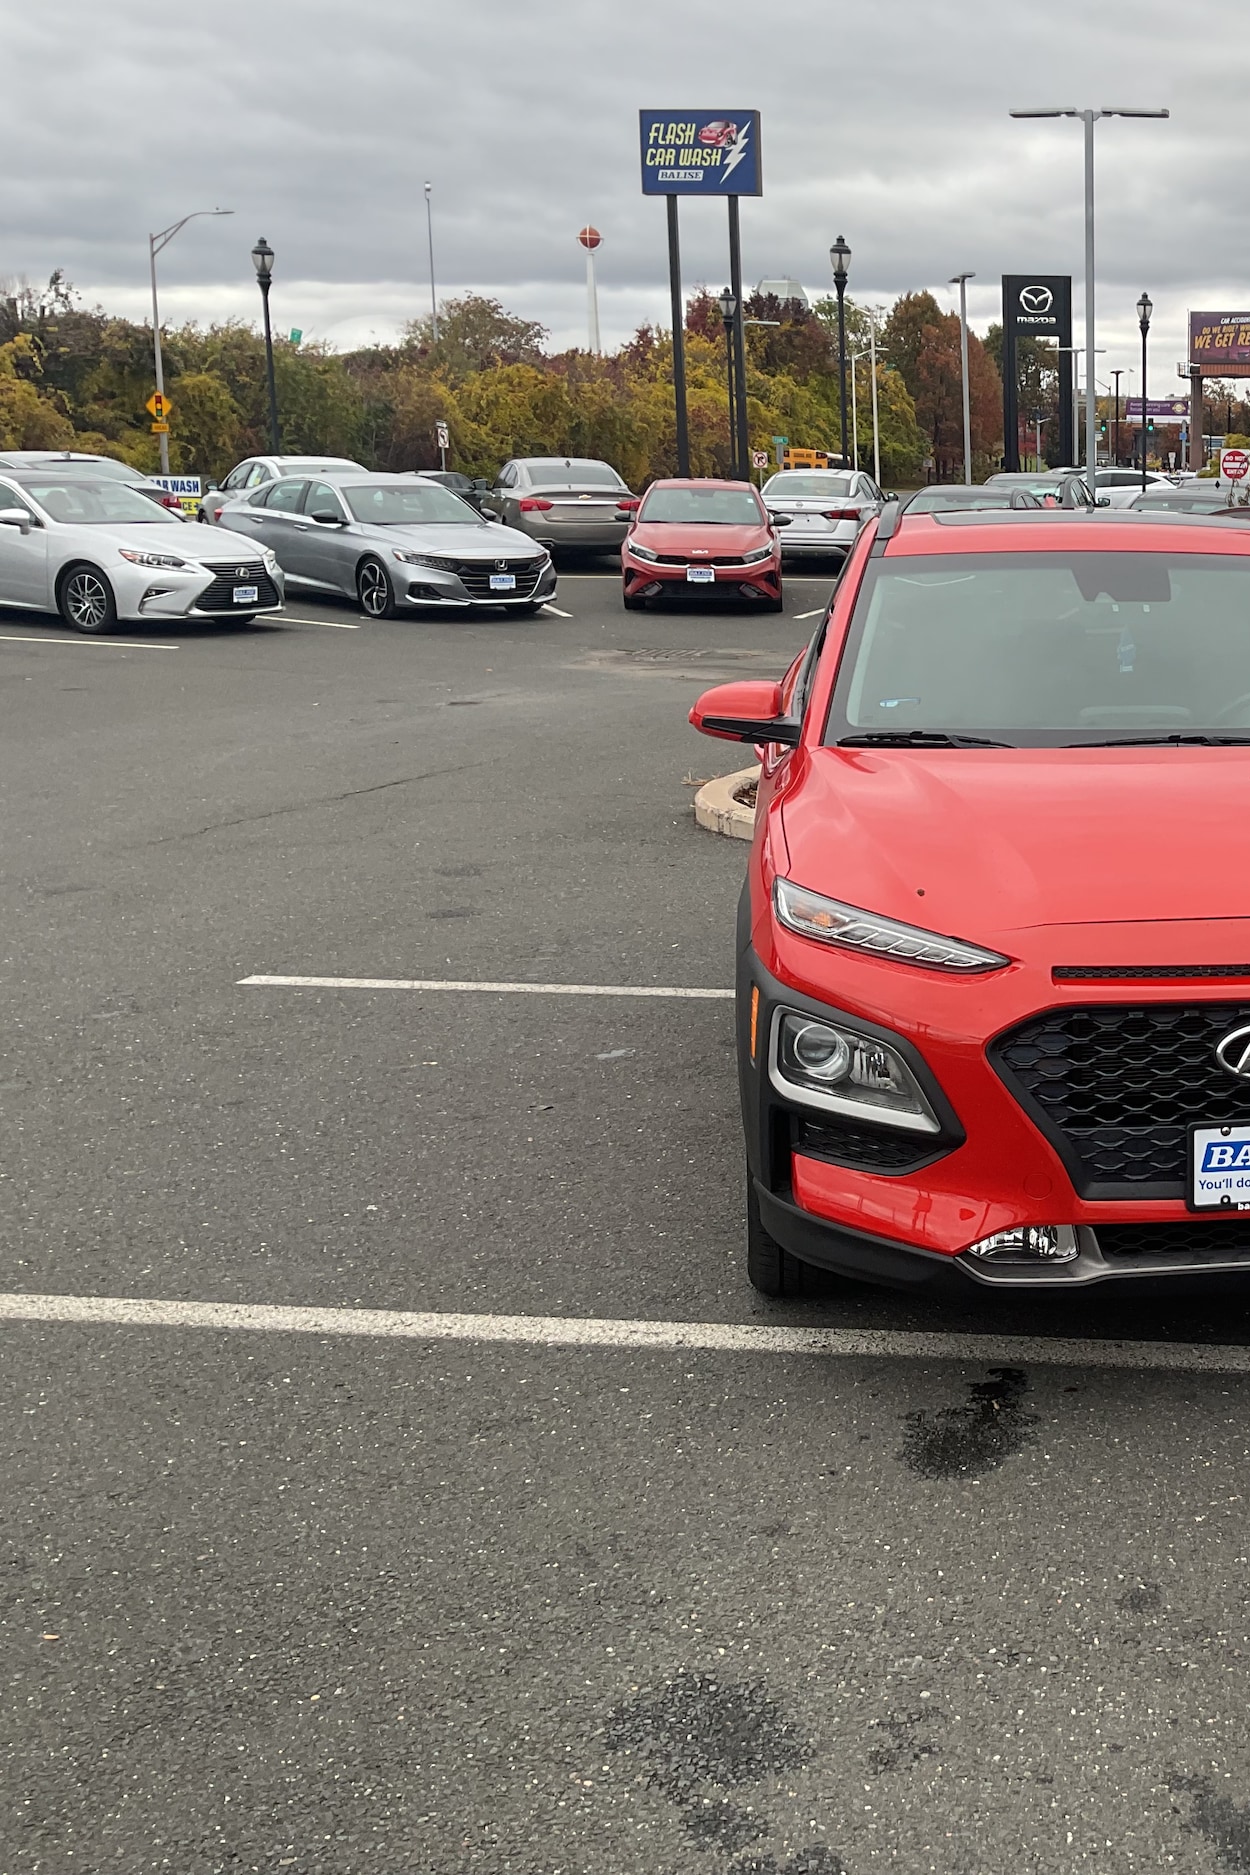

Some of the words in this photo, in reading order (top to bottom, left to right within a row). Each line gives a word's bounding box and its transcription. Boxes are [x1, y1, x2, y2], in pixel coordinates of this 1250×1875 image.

[649, 123, 696, 145] FLASH
[646, 149, 675, 166] CAR
[679, 149, 722, 166] WASH
[660, 171, 702, 179] BALISE
[1016, 316, 1057, 324] mazda
[1220, 317, 1230, 325] CAR
[1212, 326, 1222, 334] WE
[1194, 335, 1212, 349] WE
[1215, 332, 1236, 348] GET
[150, 480, 168, 490] AR
[170, 480, 199, 492] WASH
[1198, 1177, 1232, 1190] You'll
